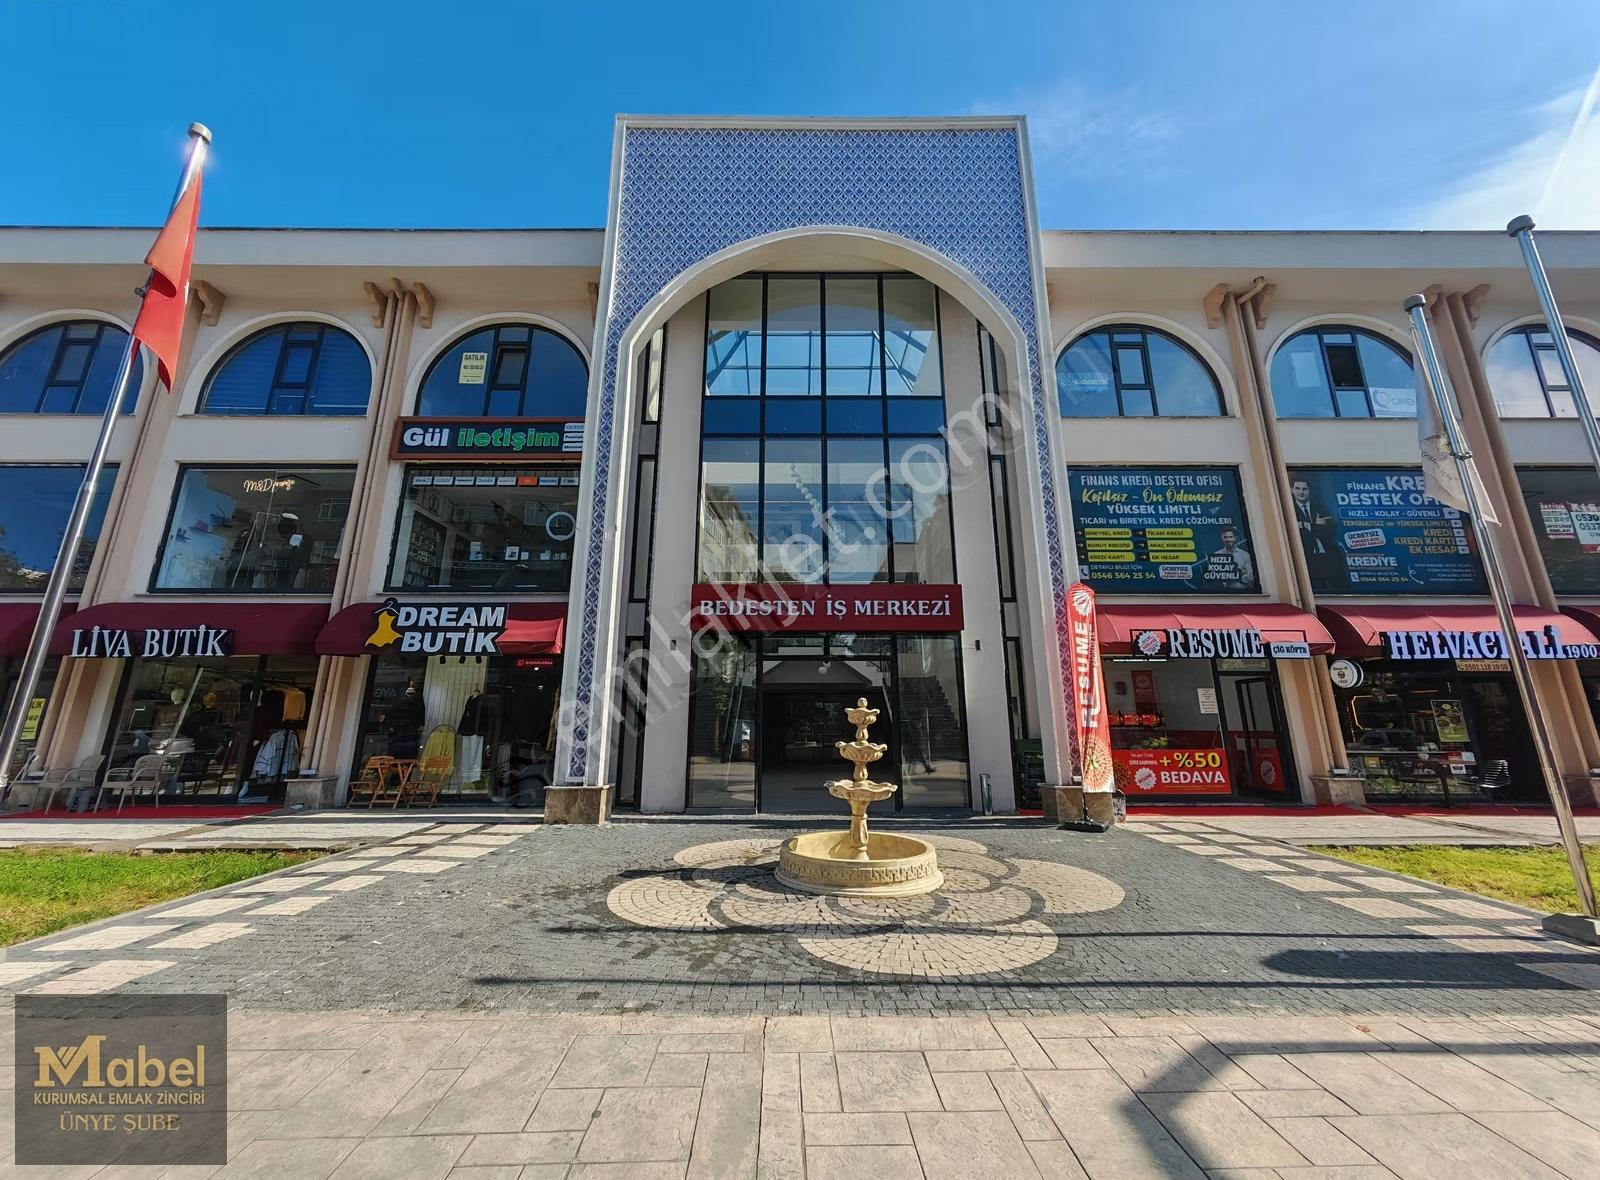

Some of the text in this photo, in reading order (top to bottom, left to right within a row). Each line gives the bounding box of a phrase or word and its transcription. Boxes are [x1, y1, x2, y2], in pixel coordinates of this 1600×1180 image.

[403, 427, 450, 447] Gül
[1081, 475, 1223, 486] FİNANS KREDİ DESTEK OFİSİ
[1347, 476, 1424, 491] FİNANS KRE
[1336, 493, 1404, 505] DESTEK
[1107, 504, 1202, 515] YÜKSEK LİMİTLİ
[1407, 509, 1440, 517] GÜVENLİ
[1119, 517, 1158, 525] BİREYSEL
[1160, 517, 1183, 525] KREDİ
[1186, 516, 1232, 526] ÇÖZÜMLERİ
[1575, 513, 1599, 522] 0530
[1423, 528, 1453, 537] KREDİ
[1393, 537, 1422, 545] KREDİ
[1425, 537, 1455, 545] KARTI
[1409, 546, 1457, 554] EK HESAP
[1210, 556, 1231, 564] HIZLI
[1346, 556, 1398, 567] KREDİYE
[1208, 564, 1235, 572] KOLAY
[1204, 571, 1240, 580] GÜVENLİ
[700, 594, 951, 620] BEDESTEN İŞ MERKEZİ
[397, 606, 505, 627] DREAM
[70, 624, 229, 658] LİVA BUTİK
[401, 628, 498, 653] BUTİK
[1166, 629, 1265, 658] RESUME
[1518, 624, 1567, 659] ALİ
[1566, 645, 1598, 658] 1900
[1160, 771, 1226, 784] BEDAVA
